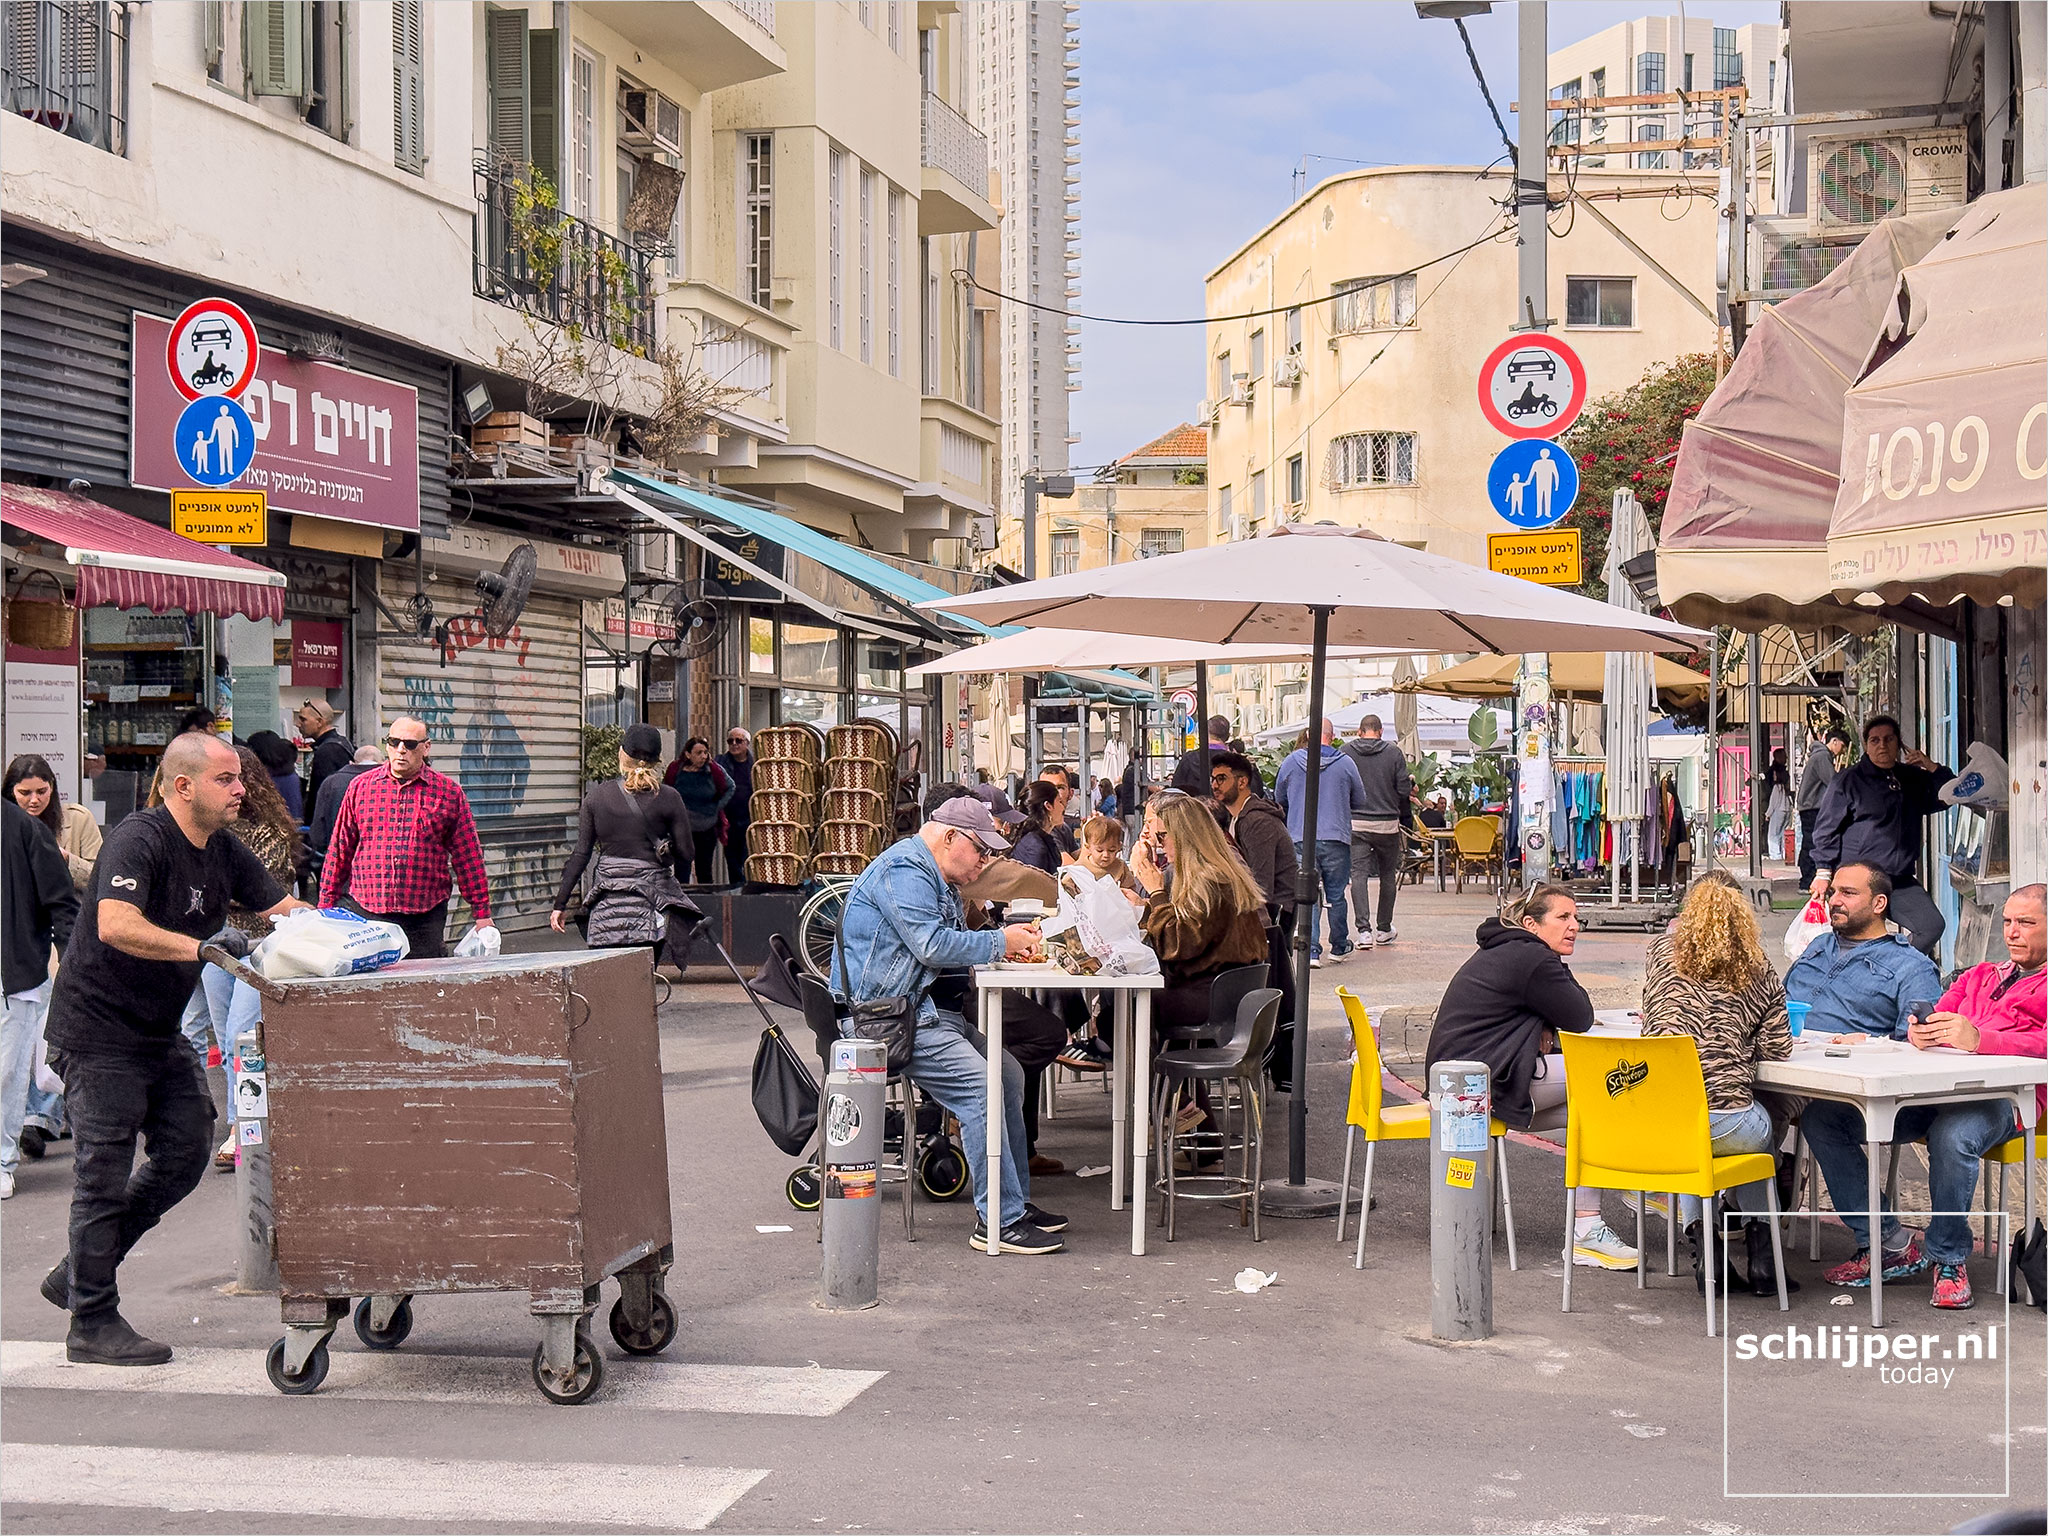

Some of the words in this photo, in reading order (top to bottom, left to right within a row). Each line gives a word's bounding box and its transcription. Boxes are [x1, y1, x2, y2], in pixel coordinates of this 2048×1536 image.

[1912, 144, 1963, 157] CROWN
[243, 377, 298, 447] רפ
[311, 391, 393, 467] חיים
[271, 468, 317, 496] בלוינסקי
[318, 480, 364, 503] המעדניה
[179, 502, 222, 514] אופניים
[226, 501, 259, 514] למעט
[185, 524, 233, 534] ממונעים
[238, 523, 254, 534] לא
[463, 534, 491, 551] דגים
[1541, 542, 1574, 554] למעט
[1495, 546, 1537, 556] אופניים
[1862, 540, 1910, 575] עלים
[1917, 539, 1959, 574] בצק
[716, 560, 759, 585] Sigm
[1502, 566, 1548, 577] ממונעים
[1553, 562, 1568, 574] לא
[610, 602, 625, 618] 34
[303, 640, 322, 655] רפאל
[323, 645, 338, 656] חיים
